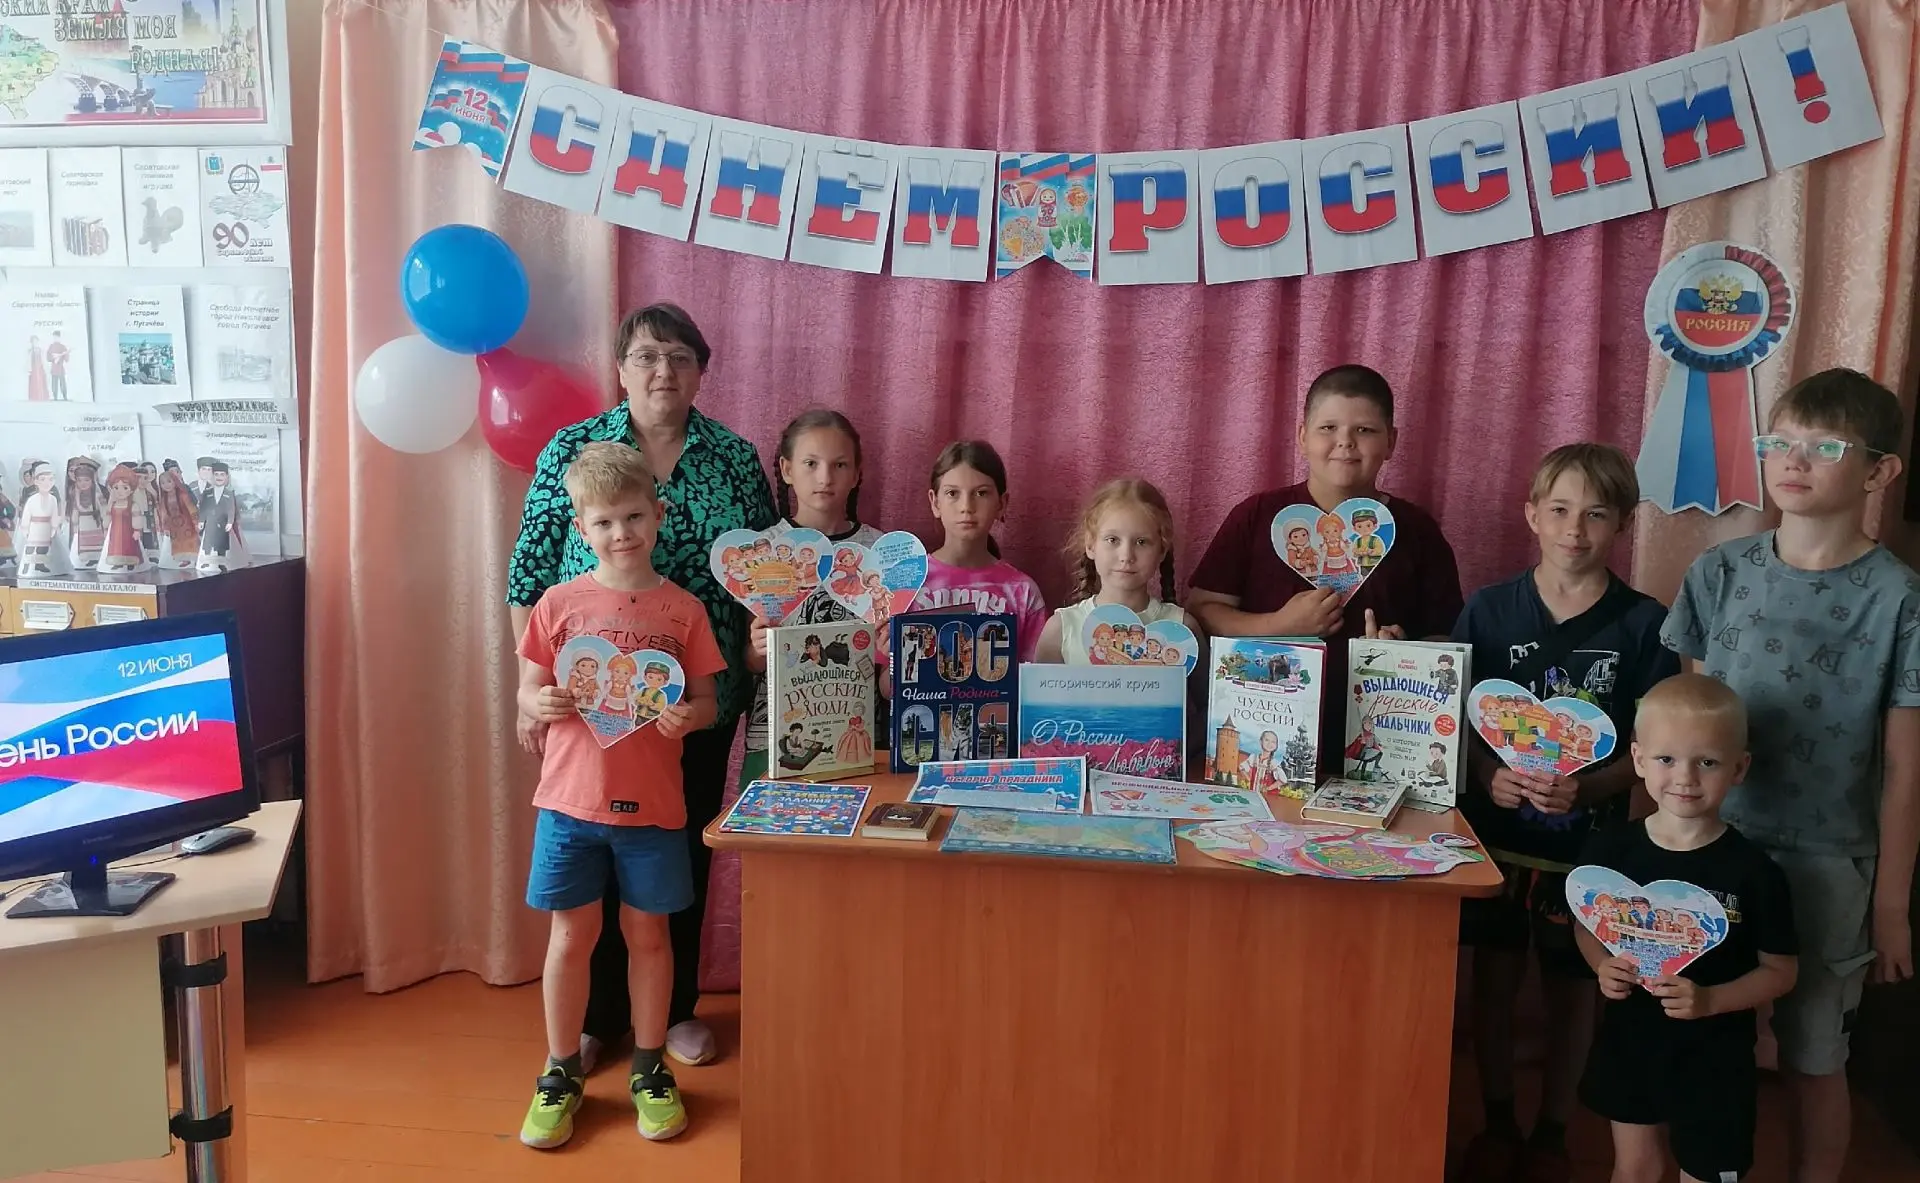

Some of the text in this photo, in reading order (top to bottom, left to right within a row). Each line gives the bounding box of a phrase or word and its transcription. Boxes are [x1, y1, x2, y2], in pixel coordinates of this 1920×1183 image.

[54, 15, 177, 41] ЗЕМЛЯ МОЯ
[464, 87, 489, 111] 12
[456, 107, 486, 123] ИЮНЯ
[213, 222, 249, 249] 90
[1686, 318, 1751, 332] РОССИЯ
[30, 580, 100, 591] СИСТЕМАТИЧЕСКИЙ
[118, 652, 193, 678] 12 ИЮНЯ
[790, 667, 861, 687] ВЫДАЮЩИЕСЯ
[1039, 678, 1160, 692] исторический круиз
[784, 682, 868, 711] РУССКИЕ
[902, 687, 947, 701] Наша
[1362, 676, 1449, 705] ВЫДАЮЩИЕСЯ
[1238, 696, 1292, 713] ЧУДЕСА
[1233, 708, 1294, 726] РОССИИ
[66, 710, 199, 755] России
[1060, 720, 1128, 747] России
